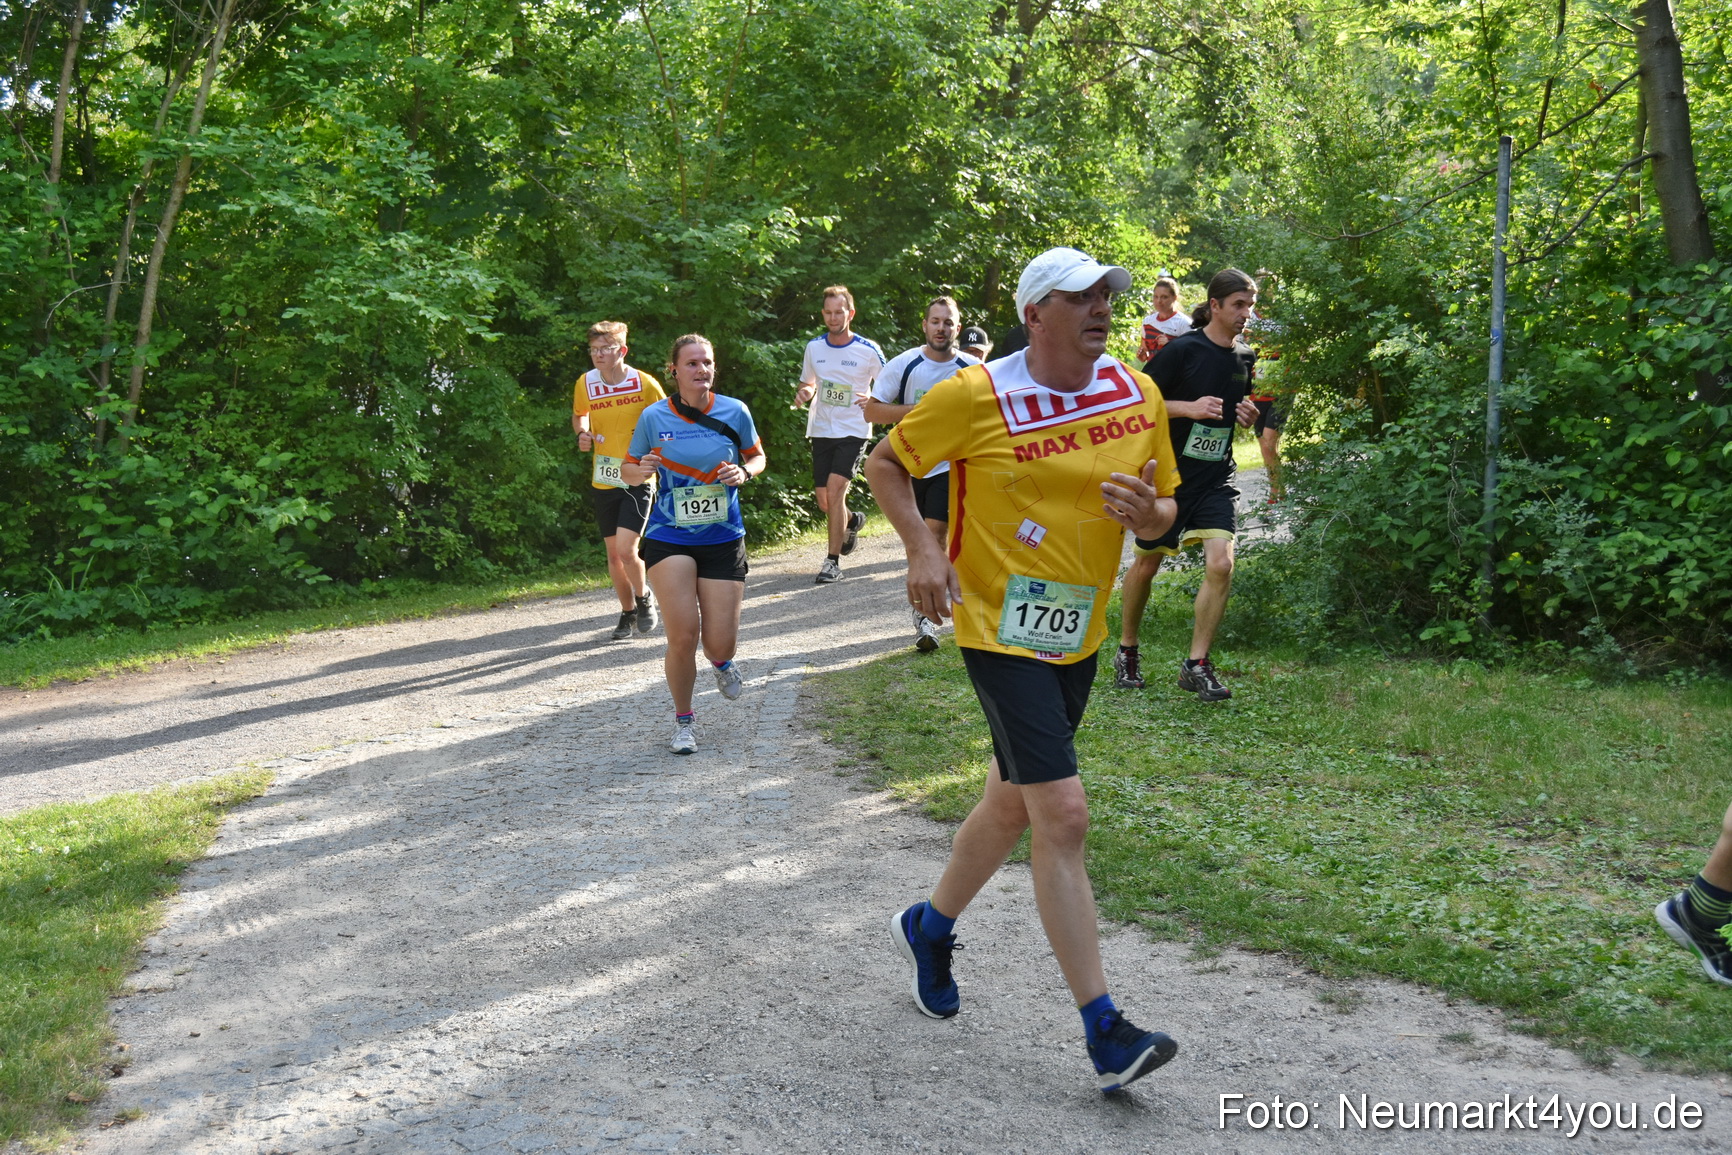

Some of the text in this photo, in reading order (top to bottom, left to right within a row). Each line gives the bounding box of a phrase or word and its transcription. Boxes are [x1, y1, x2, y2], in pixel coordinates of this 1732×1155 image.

[590, 395, 644, 411] MAX BÖGL
[826, 389, 844, 401] 936
[1013, 414, 1156, 463] MAX BÖGL
[1192, 436, 1223, 452] 2081
[600, 465, 622, 479] 168
[681, 497, 719, 515] 1921
[1016, 602, 1081, 635] 1703
[1027, 630, 1044, 638] Wolf
